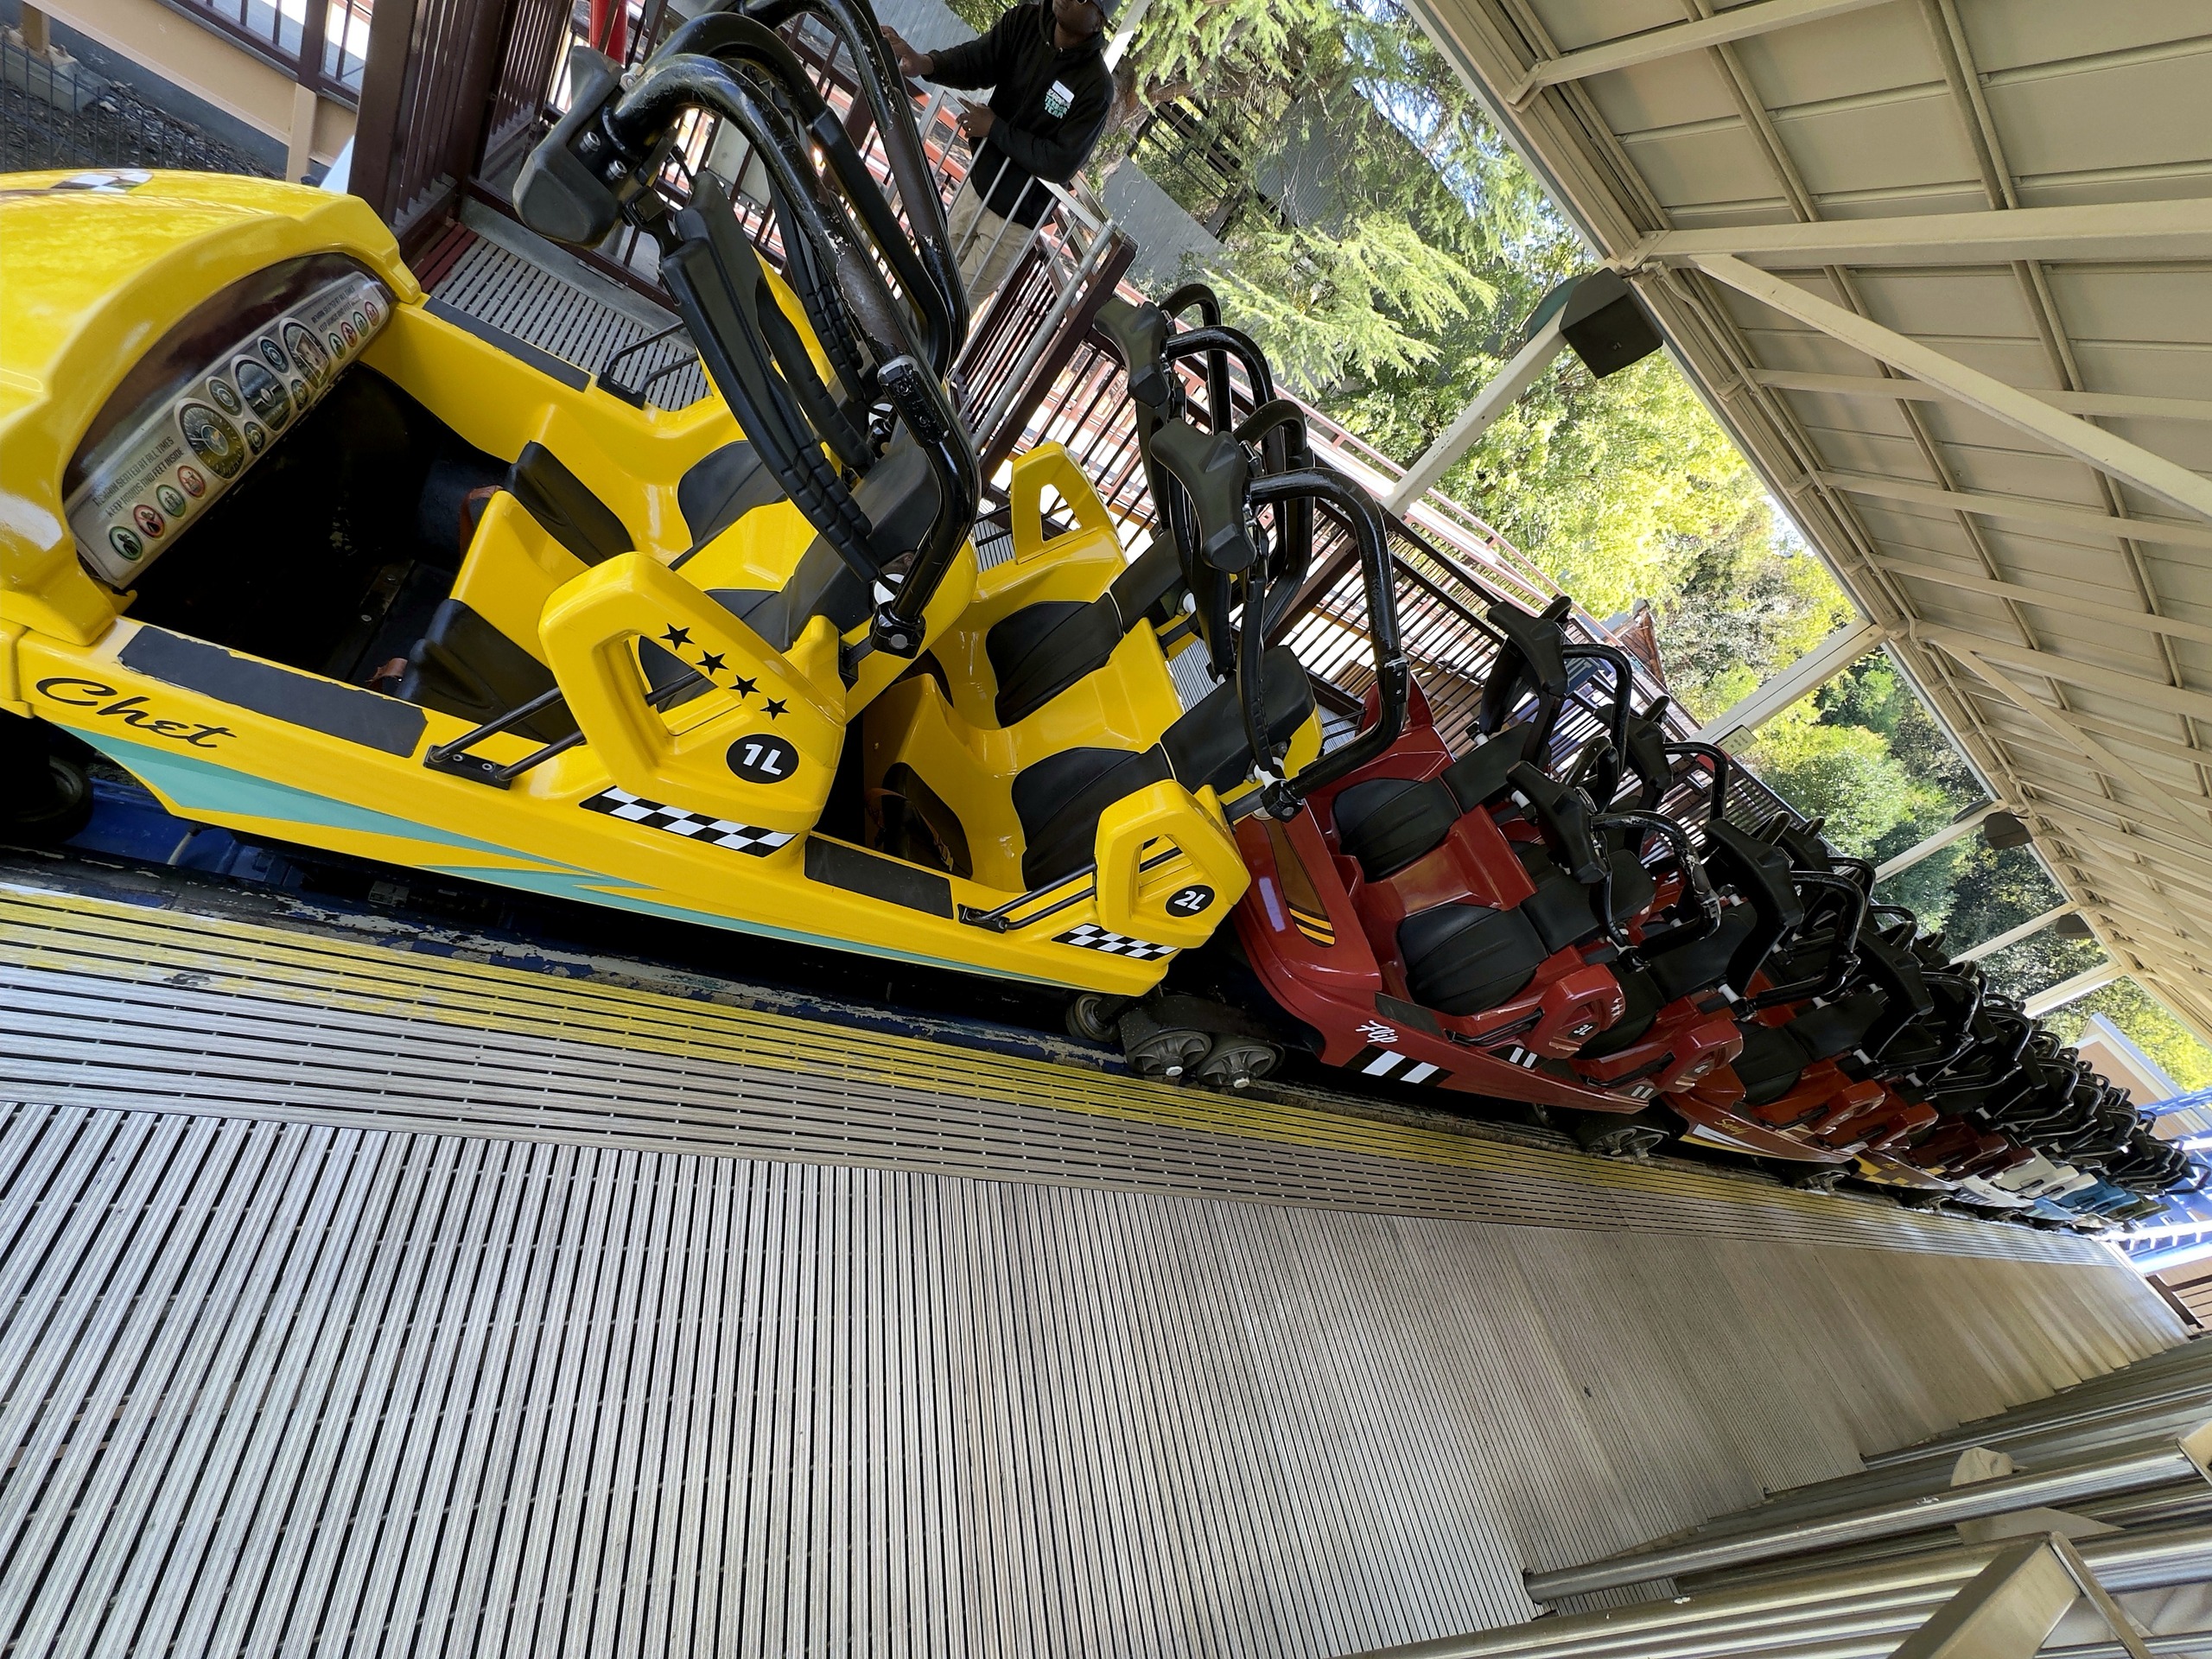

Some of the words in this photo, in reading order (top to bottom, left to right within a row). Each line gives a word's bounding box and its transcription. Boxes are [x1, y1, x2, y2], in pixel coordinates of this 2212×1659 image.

[1045, 103, 1064, 118] TEAM
[92, 482, 119, 507] REMAIN
[116, 463, 141, 487] SEATED
[137, 457, 149, 470] AT
[145, 449, 159, 463] ALL
[156, 436, 175, 454] TIMES
[105, 499, 124, 518] KEEP
[121, 481, 144, 505] HANDS
[140, 473, 156, 488] AND
[152, 461, 168, 478] FEET
[164, 448, 184, 467] INSIDE
[36, 677, 237, 748] Chet
[743, 743, 782, 775] 1L
[1173, 890, 1206, 911] 2L
[1355, 1020, 1399, 1043] Flip
[1573, 1024, 1593, 1036] 3L
